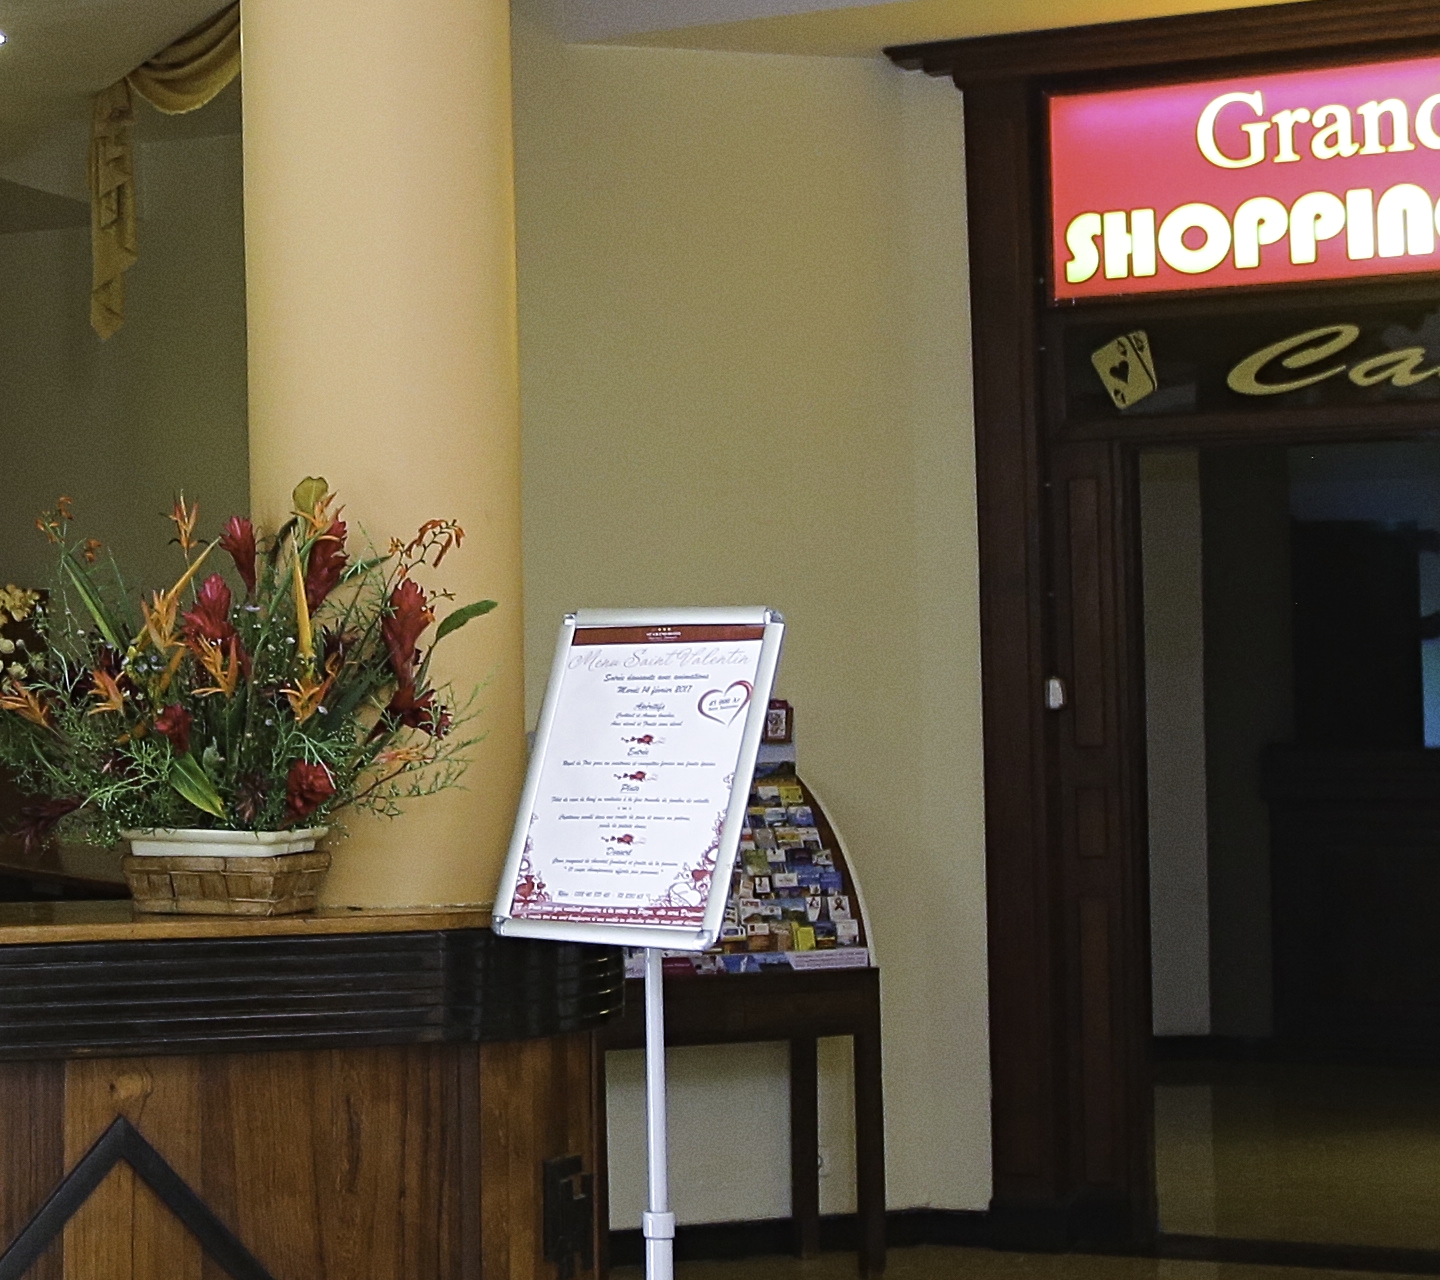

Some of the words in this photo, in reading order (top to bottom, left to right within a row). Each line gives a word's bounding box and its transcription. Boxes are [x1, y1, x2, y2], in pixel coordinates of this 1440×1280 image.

[568, 649, 618, 671] Menu
[623, 648, 678, 668] Saint
[676, 647, 751, 667] Valentin
